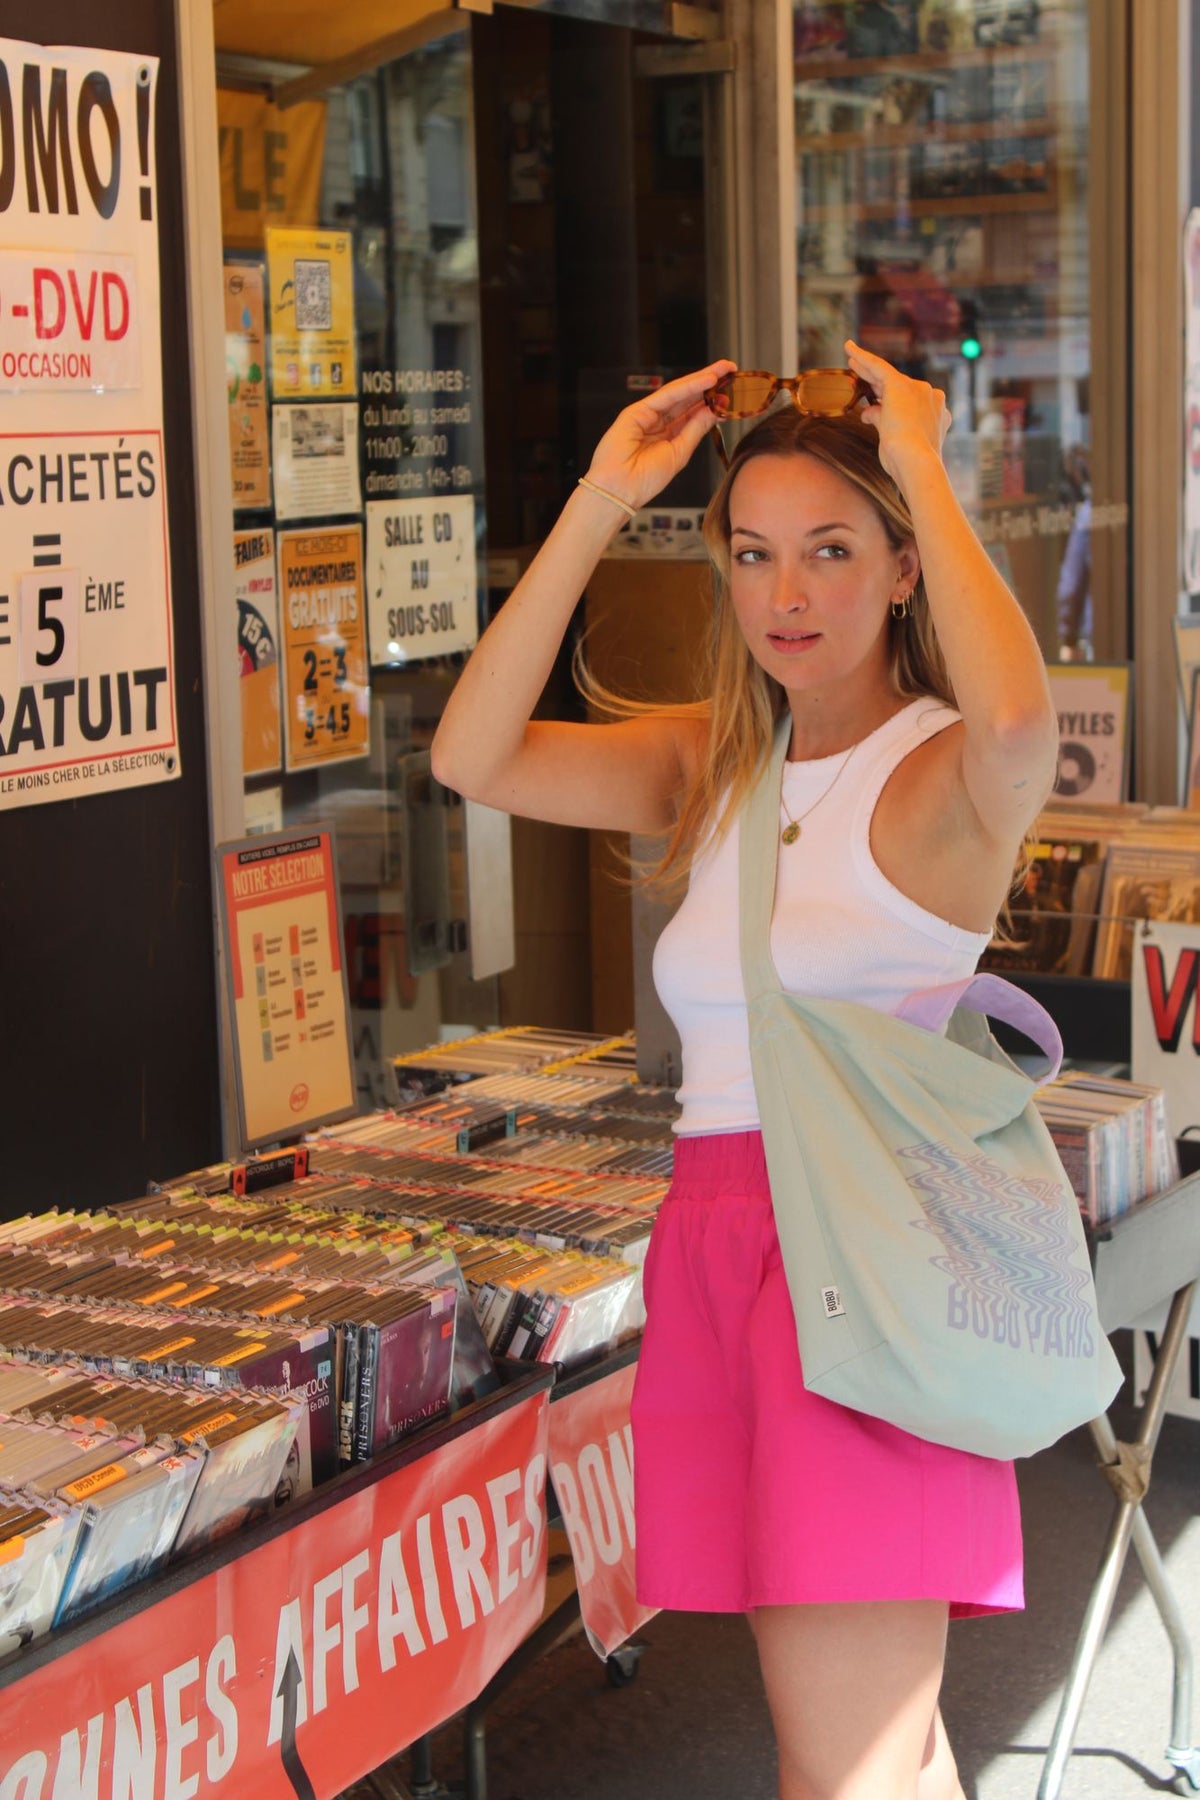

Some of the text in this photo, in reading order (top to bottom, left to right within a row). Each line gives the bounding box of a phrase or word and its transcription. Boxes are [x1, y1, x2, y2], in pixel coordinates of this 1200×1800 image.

[0, 267, 131, 342] -DVD
[2, 353, 92, 379] OCCASION
[362, 370, 392, 394] NOS
[395, 369, 463, 393] HORAIRES
[363, 404, 380, 427] du
[382, 402, 411, 427] lundi
[431, 402, 471, 425] samedi
[0, 438, 156, 505] CHETÉS
[366, 467, 424, 493] dimanche
[384, 512, 452, 547] SALLE CD
[287, 561, 357, 588] DOCUMENTAIRES
[411, 559, 430, 590] AU
[35, 586, 65, 667] 5
[84, 576, 125, 613] ÈME
[288, 585, 358, 630] GRATUITS
[387, 601, 456, 638] SOUS-SOL
[1, 751, 166, 793] LE MOINS CHER DE LA SÉLECTION
[232, 853, 325, 898] NOTRE SÉLECTION
[1142, 944, 1200, 1055] V
[825, 1290, 838, 1312] BOBO
[303, 1376, 329, 1398] COCK
[340, 1401, 354, 1461] ROCK
[358, 1367, 372, 1461] PRISONERS
[266, 1453, 547, 1748] AFFAIRES
